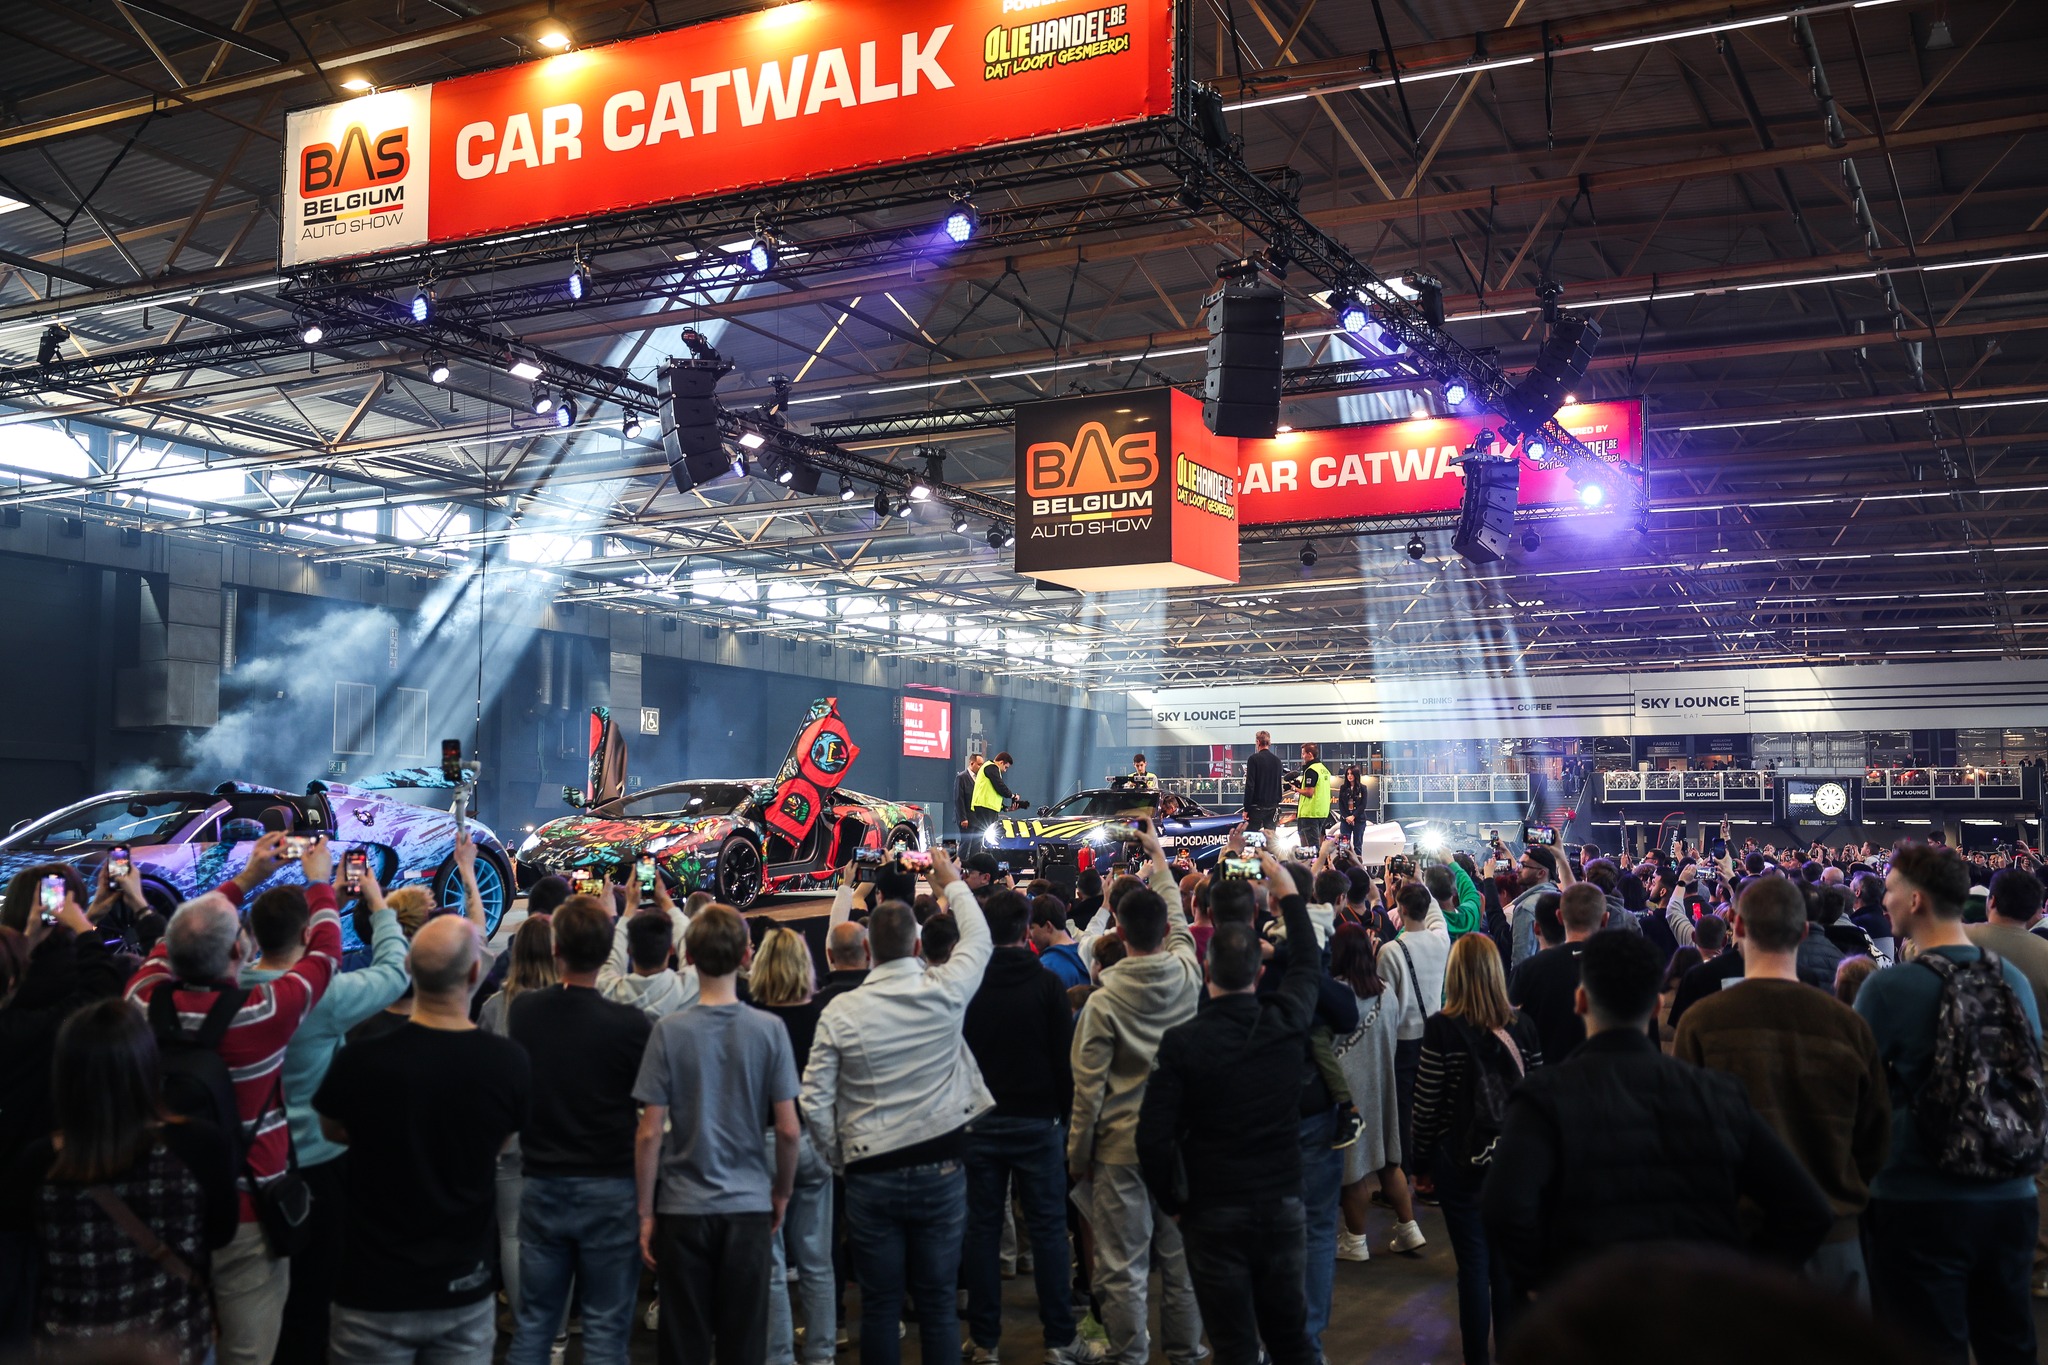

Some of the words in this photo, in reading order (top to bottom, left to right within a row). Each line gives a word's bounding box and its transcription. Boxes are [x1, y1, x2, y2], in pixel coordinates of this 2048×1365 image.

[985, 62, 1011, 80] DAT
[1013, 52, 1056, 73] LOOPT
[1057, 35, 1129, 64] GESMEERD!
[455, 103, 583, 180] CAR
[602, 24, 955, 152] CATWALK
[304, 126, 405, 192] BAS
[304, 185, 404, 217] BELGIUM
[302, 222, 347, 241] AUTO
[350, 212, 404, 233] SHOW
[1596, 425, 1608, 433] BY
[1033, 429, 1153, 490] BAS
[1238, 460, 1298, 495] AR
[1033, 491, 1153, 516] BELGIUM
[1177, 488, 1189, 505] DAT
[1189, 493, 1207, 511] LOOPT
[1031, 521, 1084, 539] AUTO
[1088, 517, 1153, 534] SHOW
[905, 702, 919, 712] HALL
[1422, 697, 1453, 705] DRINKS
[1517, 703, 1552, 711] COFFEE
[1641, 697, 1670, 709] SKY
[1675, 695, 1740, 708] LOUNGE
[905, 719, 919, 728] HALL
[1157, 712, 1180, 722] SKY
[1184, 710, 1236, 721] LOUNGE
